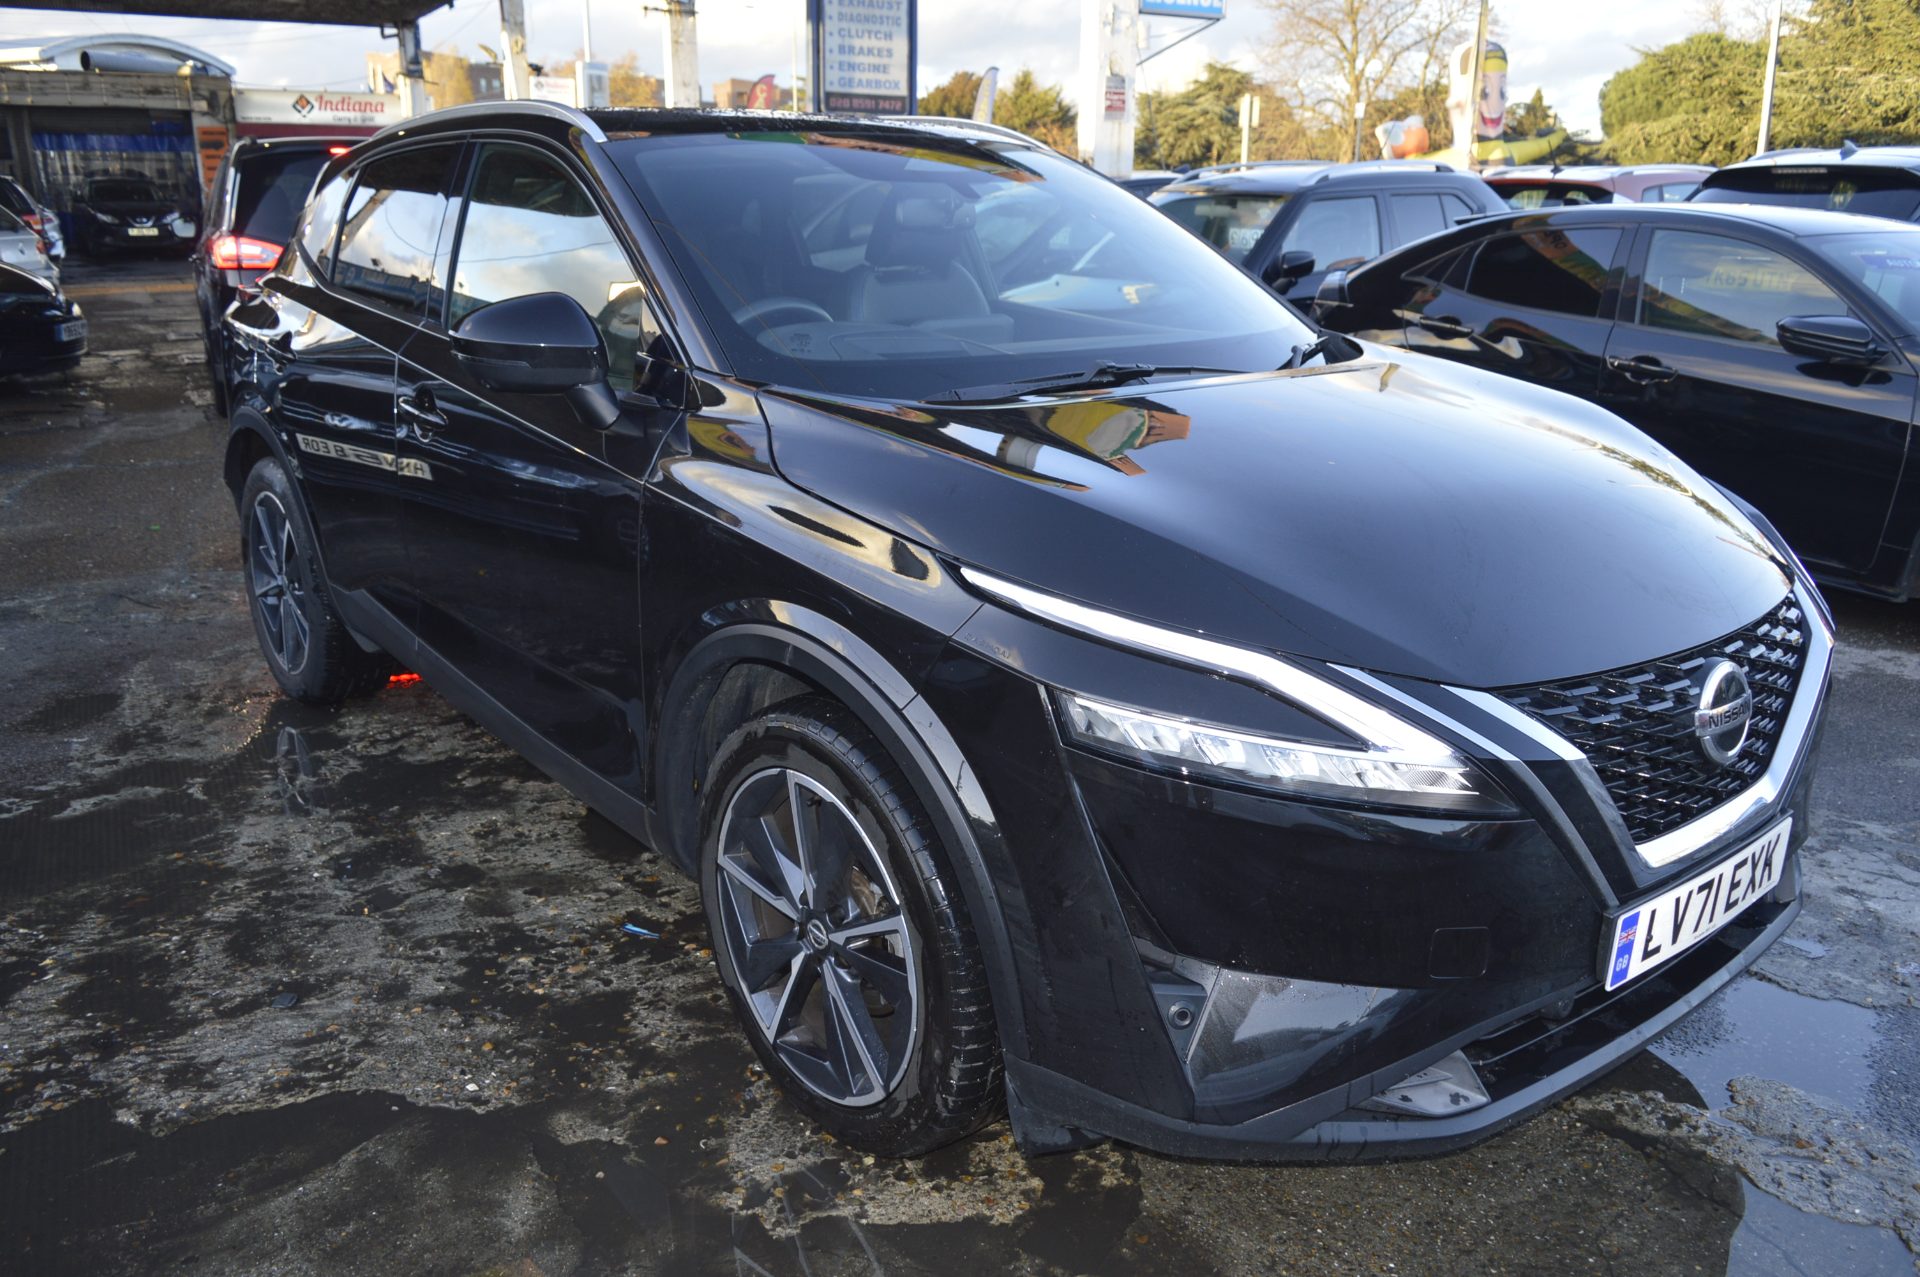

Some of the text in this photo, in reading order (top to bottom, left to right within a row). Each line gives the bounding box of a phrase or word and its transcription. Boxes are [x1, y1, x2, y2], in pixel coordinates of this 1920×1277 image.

[837, 11, 902, 27] DIAGNOSTIC
[837, 27, 893, 41] CLUTCH
[838, 44, 893, 58] BRAKES
[838, 60, 890, 74] ENGINE
[838, 77, 901, 90] GEARBOX
[315, 92, 384, 113] Indiana
[1708, 702, 1750, 729] NISSAN
[1616, 954, 1628, 972] GB
